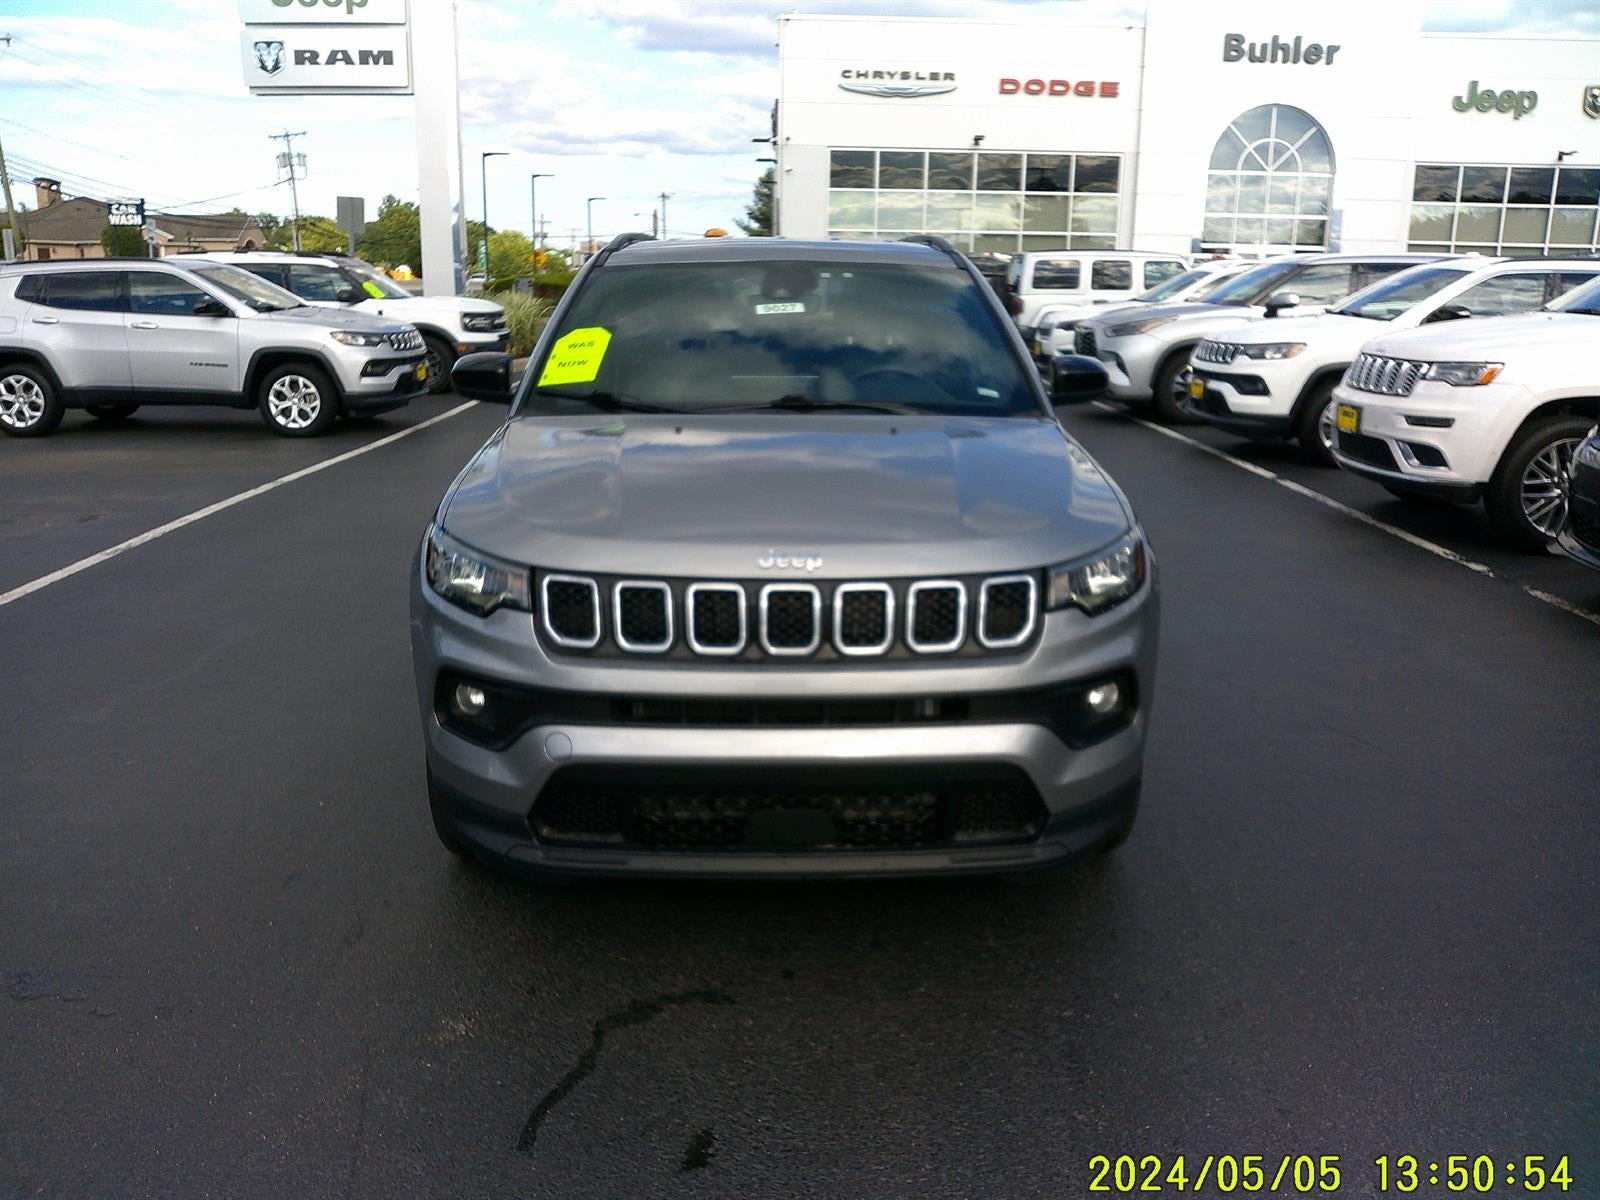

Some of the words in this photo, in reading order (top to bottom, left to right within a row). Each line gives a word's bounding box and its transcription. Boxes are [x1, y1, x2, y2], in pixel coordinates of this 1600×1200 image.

[294, 49, 394, 66] RAM
[1223, 33, 1341, 66] Buhler
[841, 69, 956, 81] CHRYSLER
[999, 78, 1120, 98] DODGE
[1452, 80, 1539, 120] Jeep
[107, 213, 142, 225] WASH
[568, 340, 595, 349] WAS
[557, 360, 589, 368] NOW
[757, 549, 823, 571] Jeep
